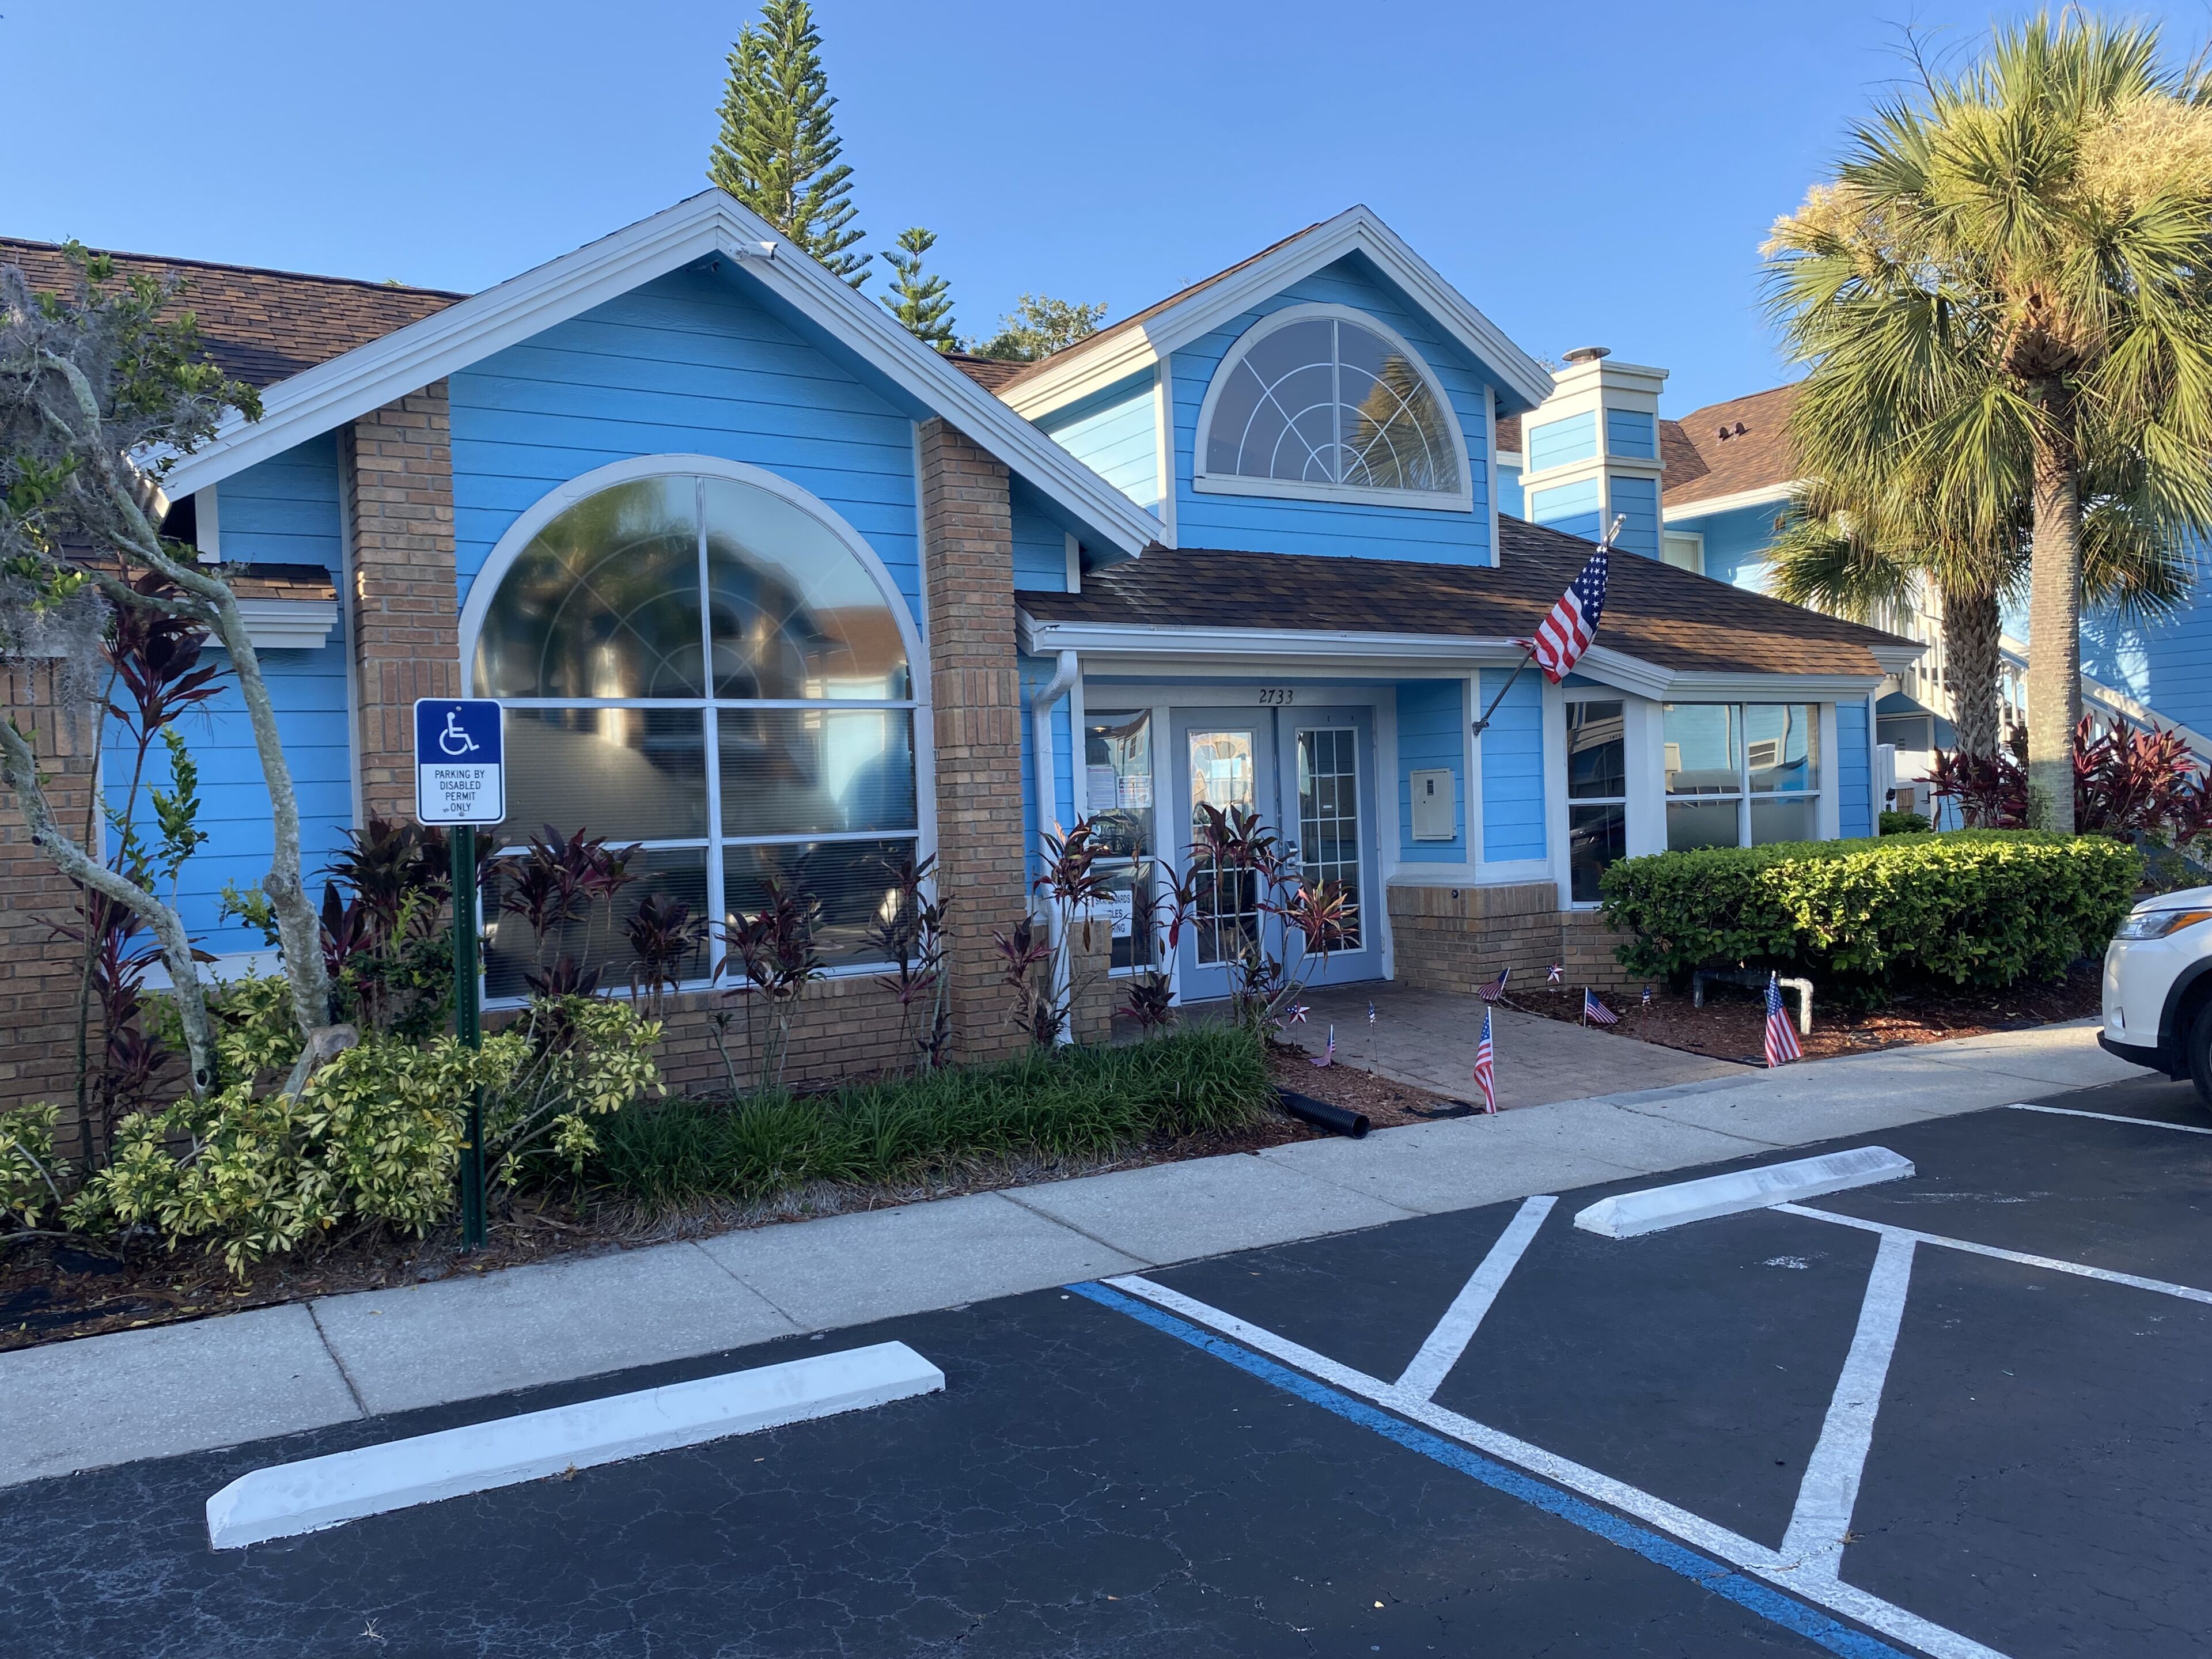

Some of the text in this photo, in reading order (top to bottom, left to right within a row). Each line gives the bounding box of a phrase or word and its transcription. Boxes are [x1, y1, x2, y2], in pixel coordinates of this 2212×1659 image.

[1259, 689, 1293, 704] 2733
[435, 770, 485, 779] PARKING BY
[440, 781, 481, 790] DISABLED
[445, 792, 476, 801] PERMIT
[450, 802, 471, 812] ONLY
